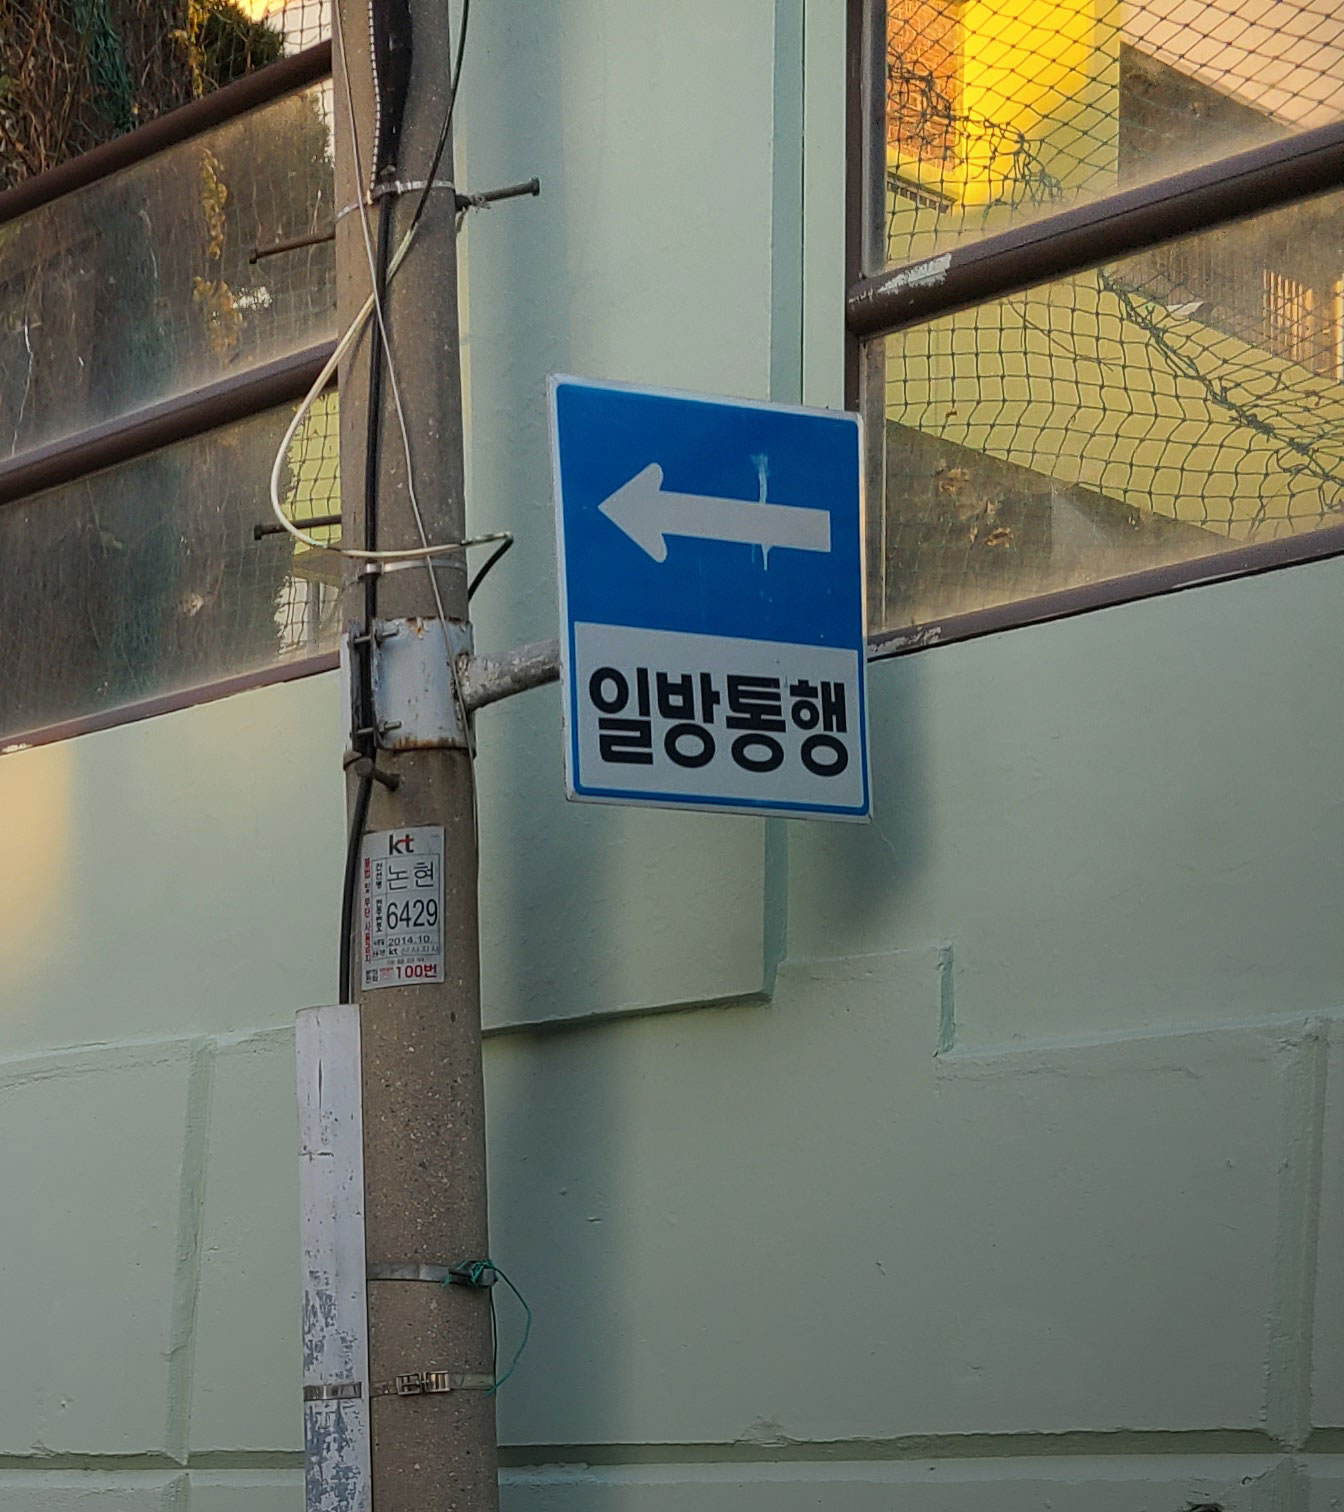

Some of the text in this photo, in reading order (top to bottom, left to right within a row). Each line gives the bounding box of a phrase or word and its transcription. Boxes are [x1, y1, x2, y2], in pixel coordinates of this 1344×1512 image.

[588, 666, 849, 777] 일방통행
[389, 833, 415, 855] kt
[387, 861, 434, 891] 논현
[386, 898, 438, 930] 6429
[395, 963, 438, 979] 100번
